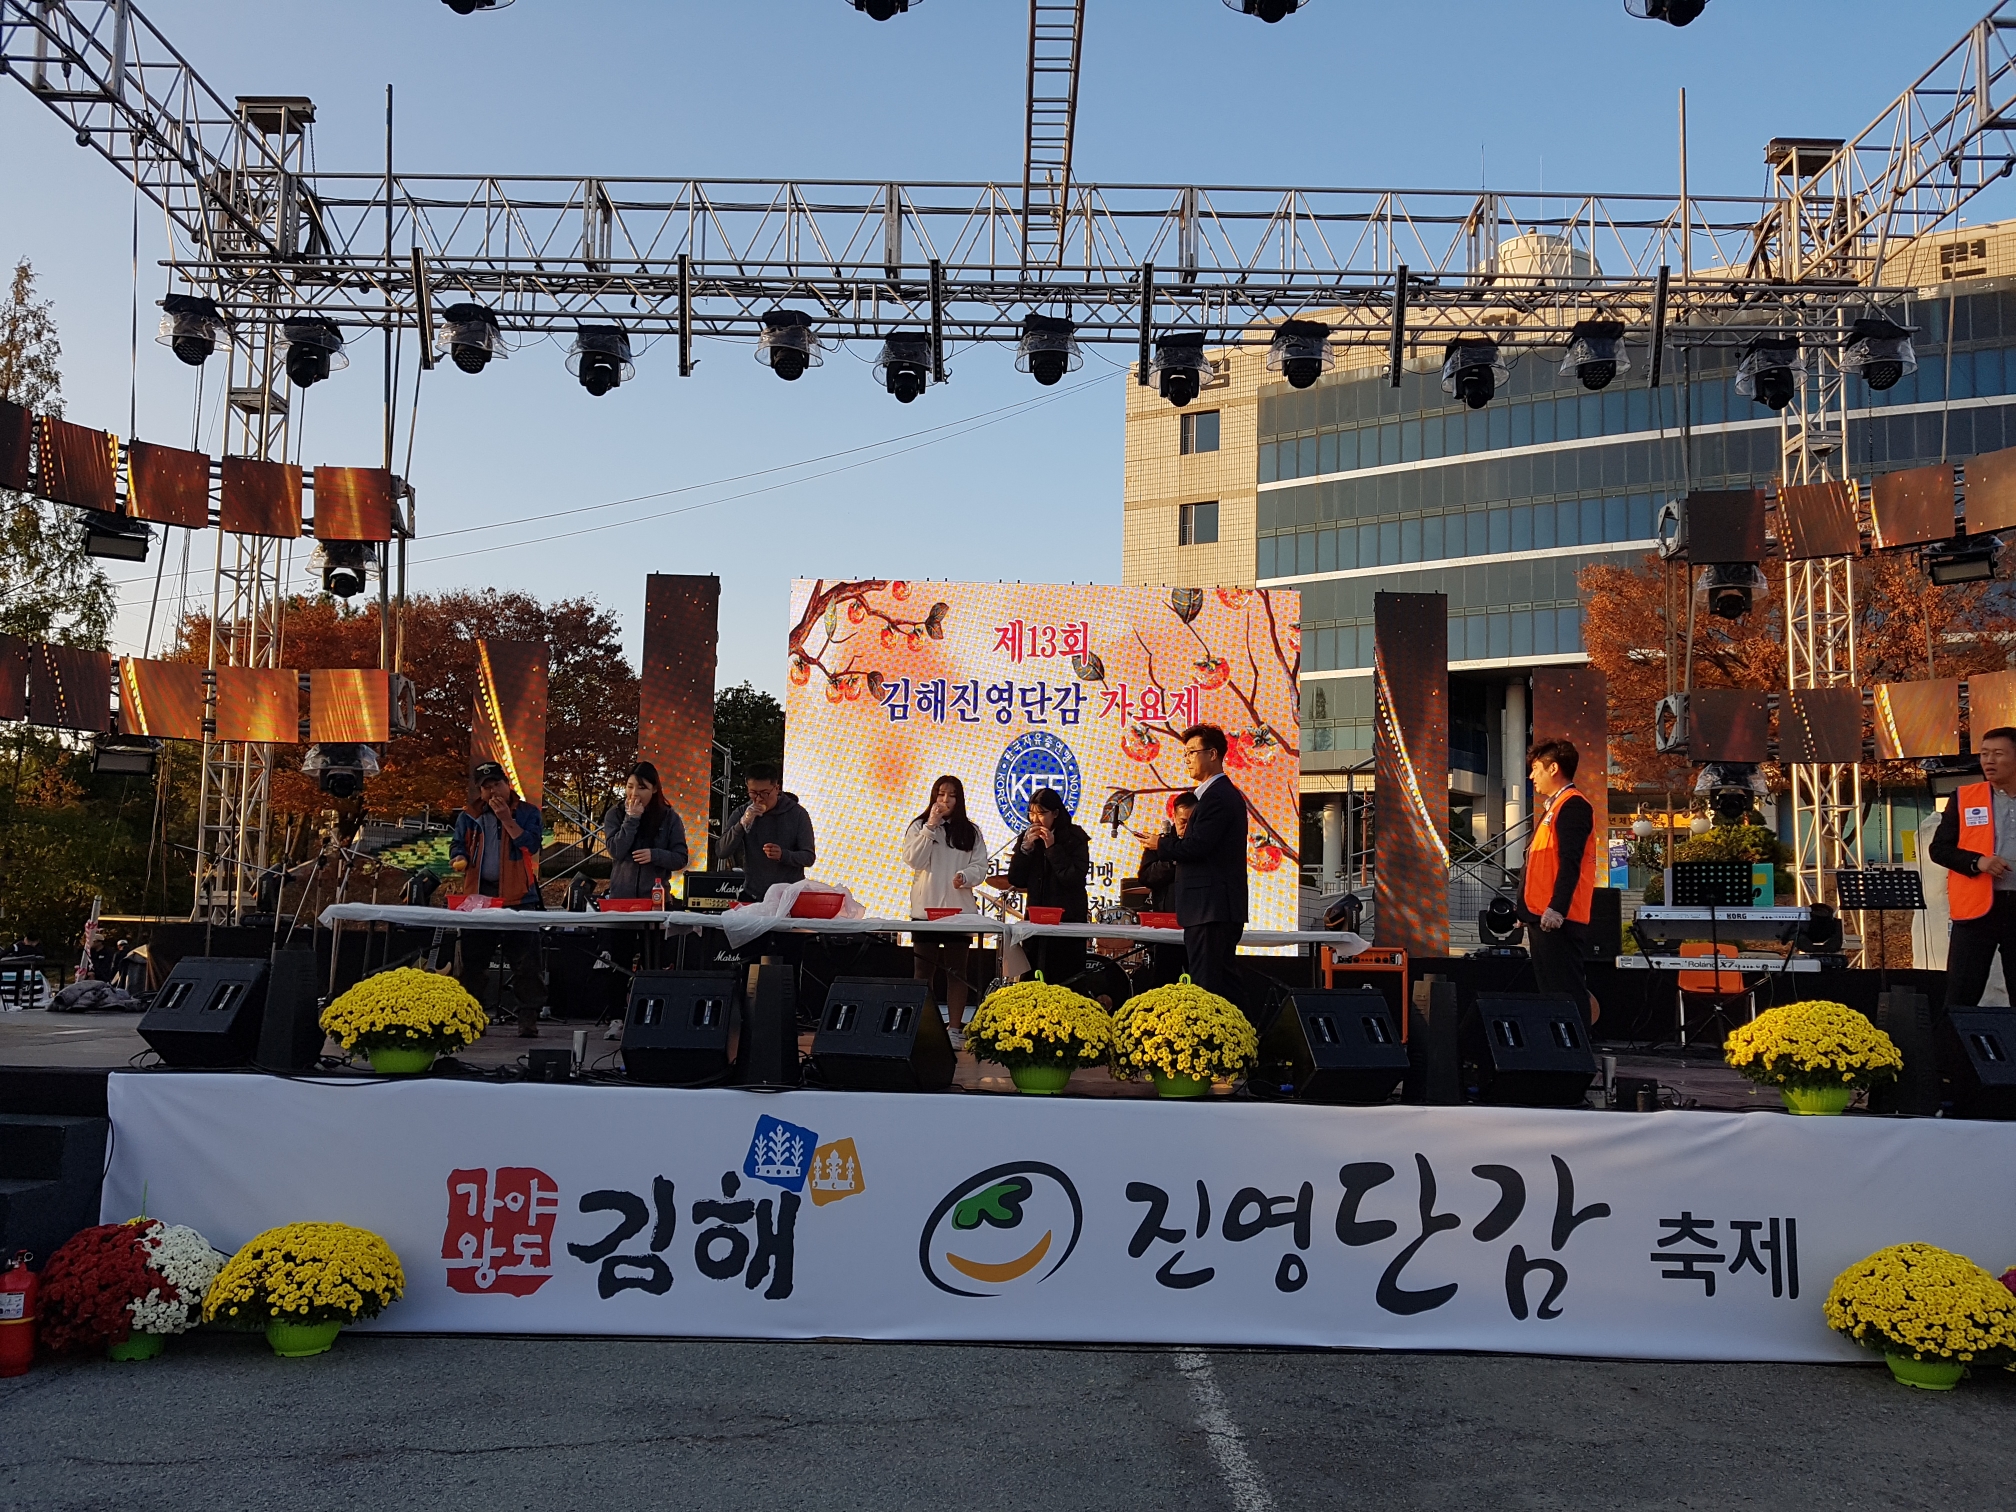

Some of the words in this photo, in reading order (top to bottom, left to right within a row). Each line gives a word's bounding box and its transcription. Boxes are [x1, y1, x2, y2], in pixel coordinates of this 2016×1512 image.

[993, 619, 1089, 665] 제13회
[881, 678, 1087, 726] 김해진영단감
[1099, 683, 1199, 728] 가요제
[996, 772, 1008, 811] KOREA
[713, 950, 741, 961] Marsh
[456, 1170, 559, 1225] 가야
[441, 1227, 554, 1289] 왕도
[567, 1170, 801, 1300] 김해
[1125, 1153, 1611, 1321] 진영단감
[1649, 1211, 1799, 1299] 축제
